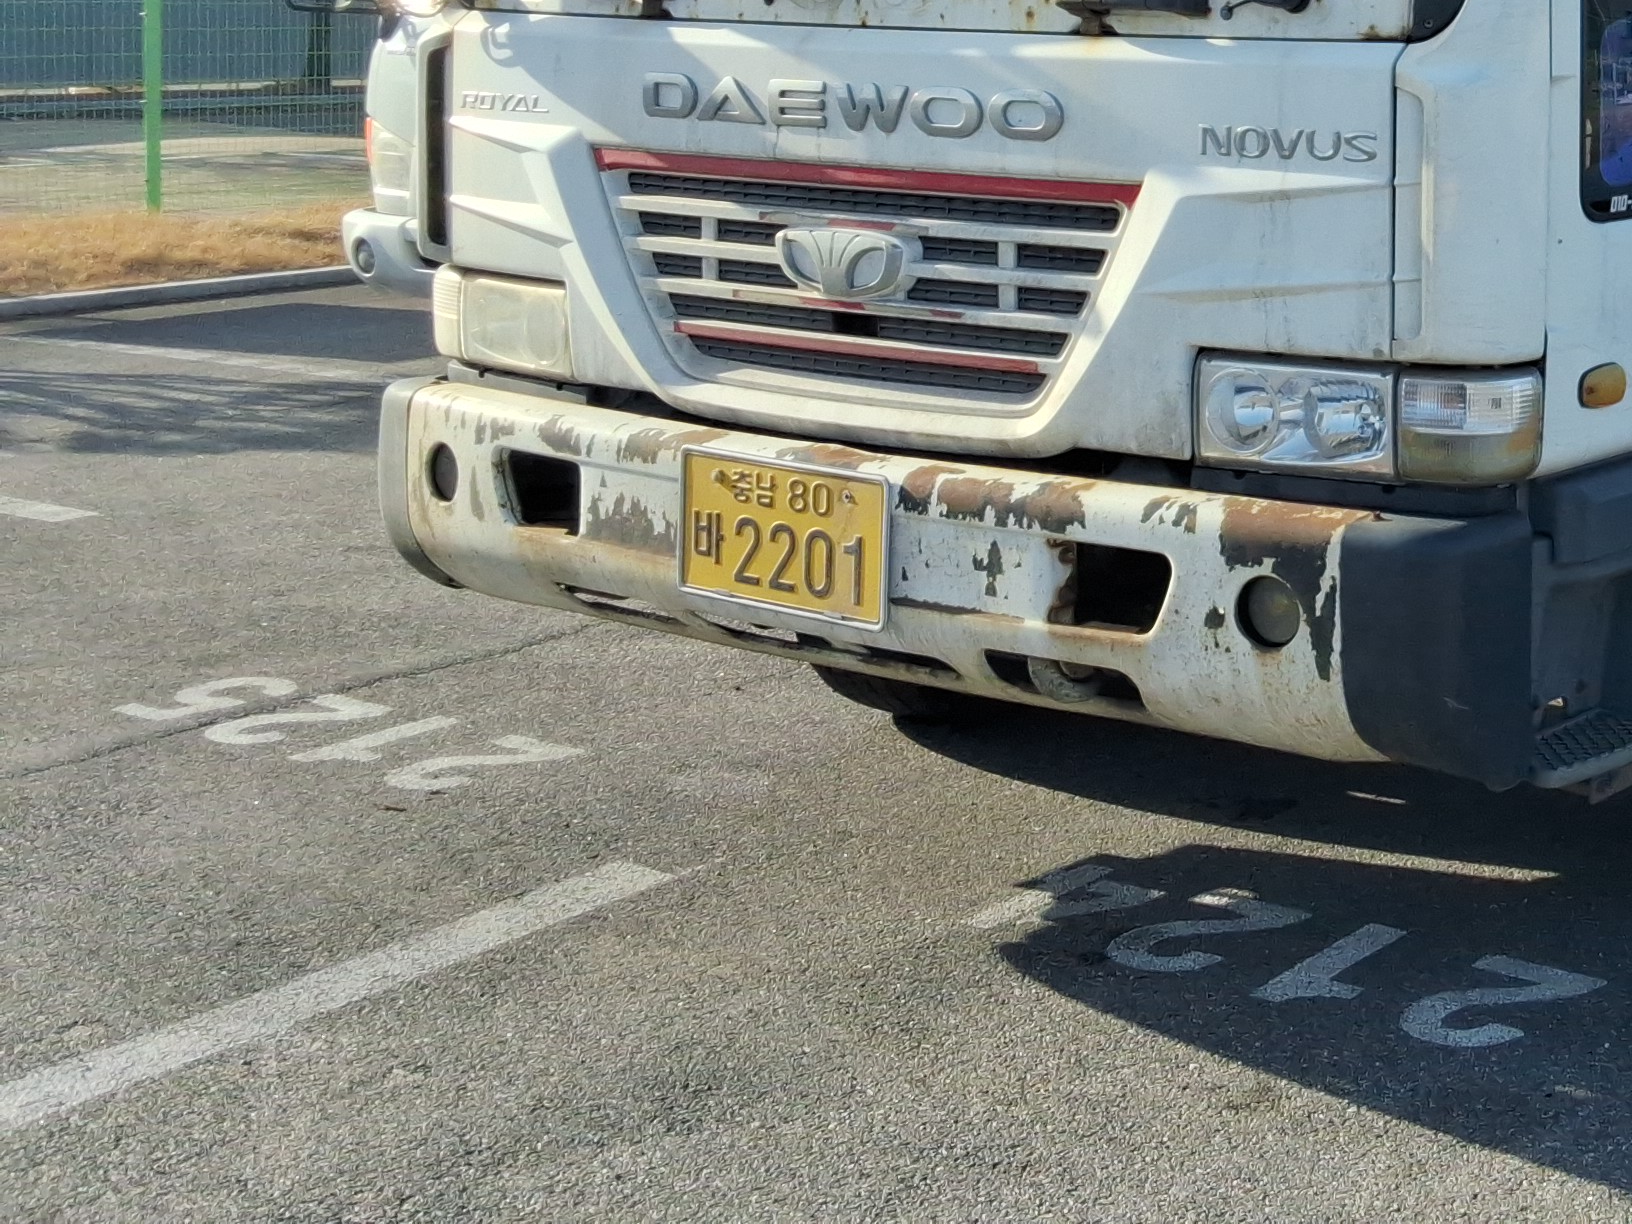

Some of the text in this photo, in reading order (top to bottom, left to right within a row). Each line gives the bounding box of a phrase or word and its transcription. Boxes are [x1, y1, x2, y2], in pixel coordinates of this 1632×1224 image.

[461, 91, 549, 113] ROYAL
[642, 72, 1064, 141] DAEWOO
[1199, 123, 1377, 162] NOVUS
[731, 469, 832, 516] 충남 80
[693, 509, 863, 605] 바 2201
